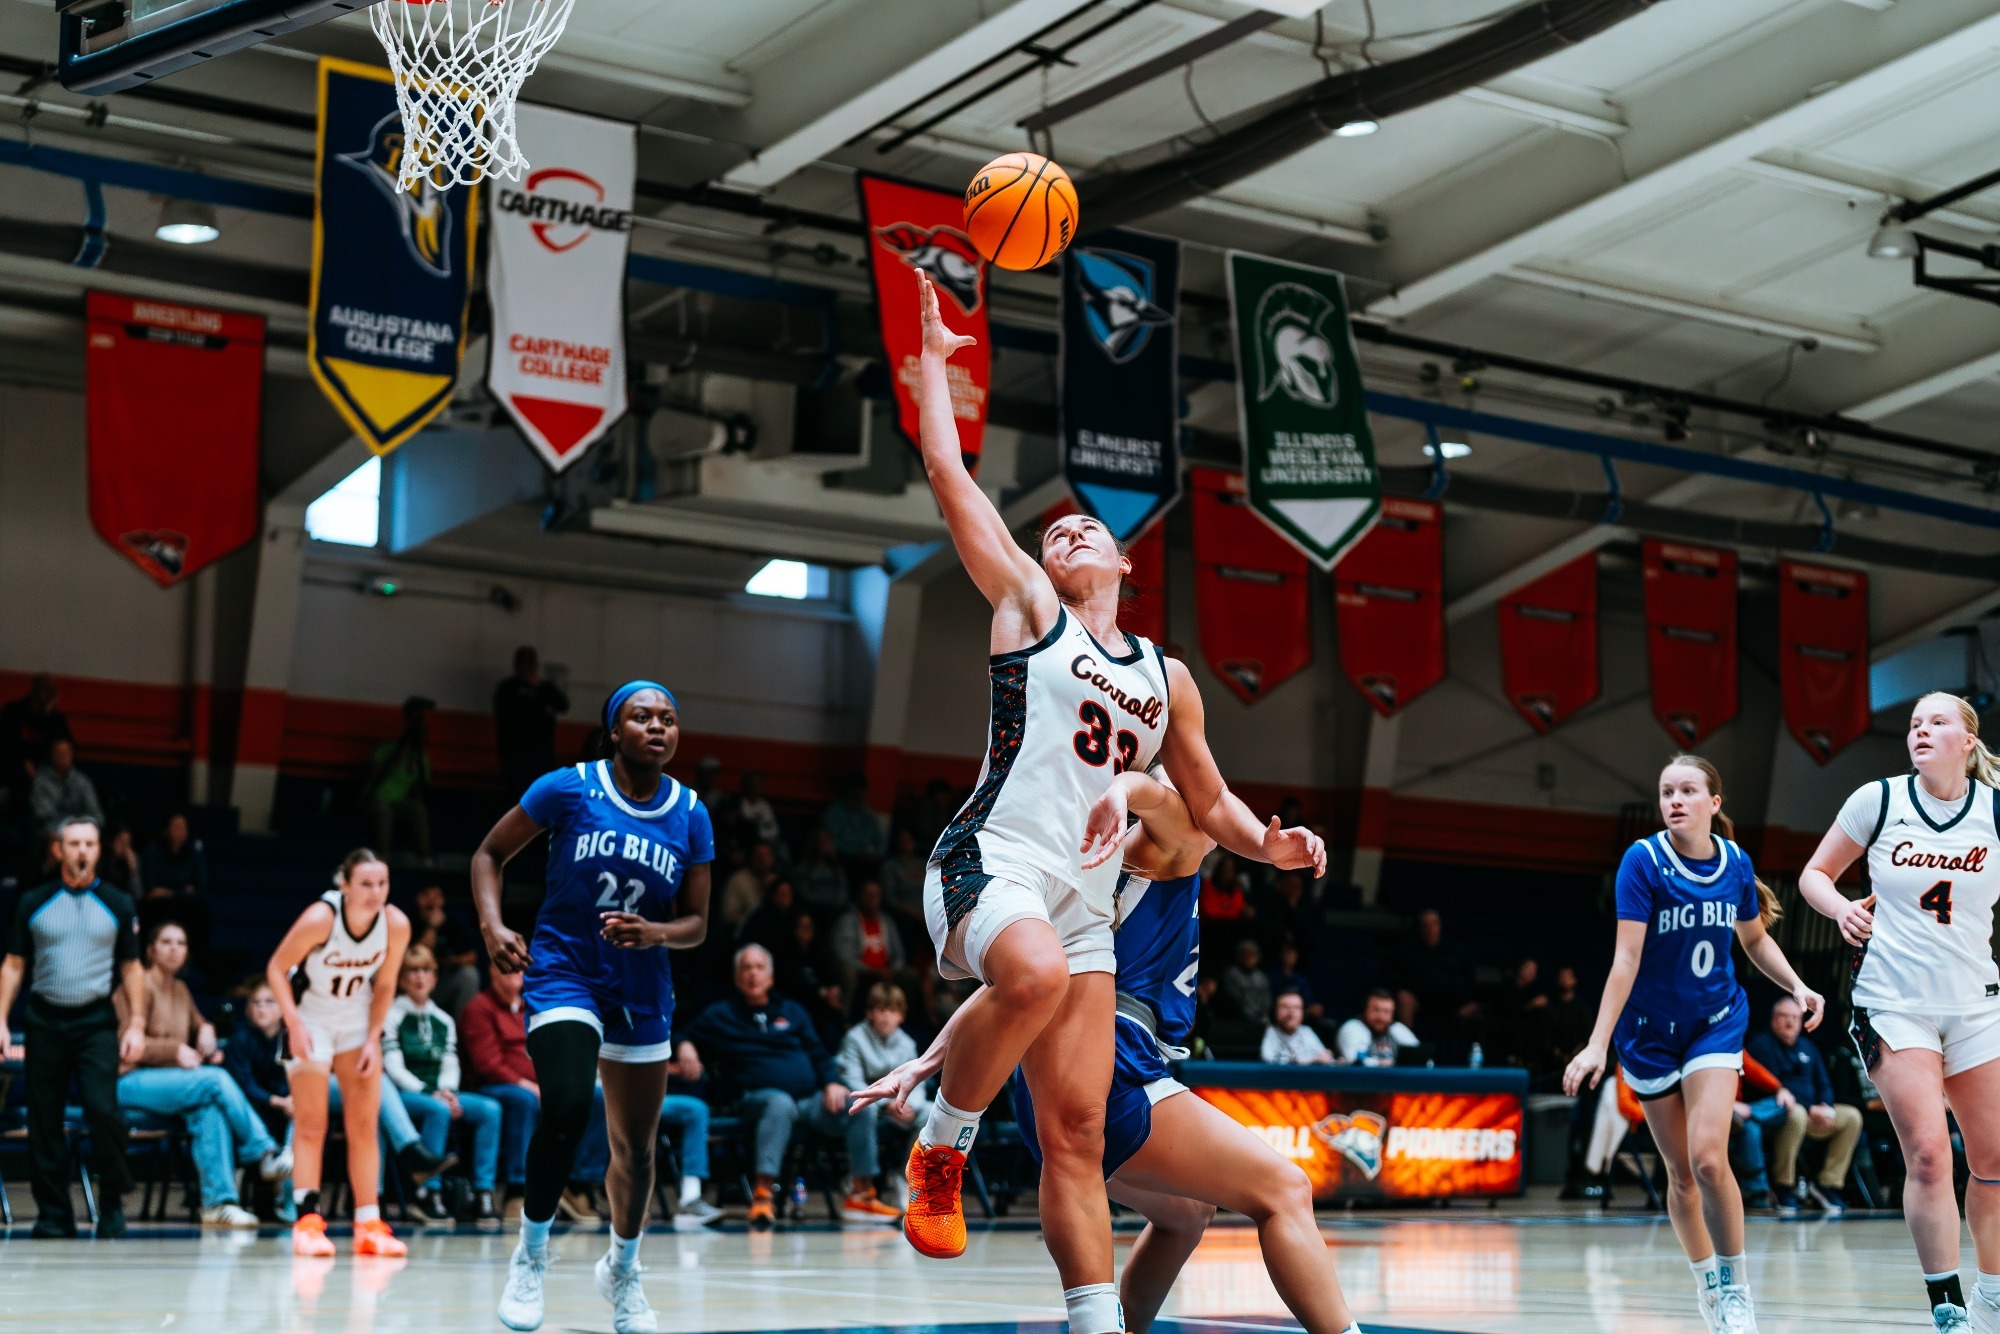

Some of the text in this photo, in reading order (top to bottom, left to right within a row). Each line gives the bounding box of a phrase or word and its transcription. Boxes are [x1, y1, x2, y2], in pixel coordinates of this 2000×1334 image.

[498, 187, 629, 232] CARTHAGE
[329, 304, 454, 343] AUGUSTANA
[345, 328, 436, 363] COLLEGE
[508, 333, 612, 366] CARTHAGE
[519, 355, 603, 385] COLLEGE
[1078, 428, 1161, 458] ELMHURST
[1267, 448, 1365, 465] WESLEYAN
[1274, 431, 1356, 449] ILLINOIS
[1261, 465, 1372, 484] UNIVERSITY
[1071, 653, 1163, 731] Carroll
[574, 829, 678, 885] BIG BLUE
[1891, 841, 1988, 873] Carroll
[595, 870, 646, 915] 22
[1919, 880, 1953, 926] 4
[1658, 902, 1696, 935] BIG
[1691, 939, 1716, 979] 0
[331, 974, 365, 998] 10
[1386, 1126, 1517, 1161] PIONEERS
